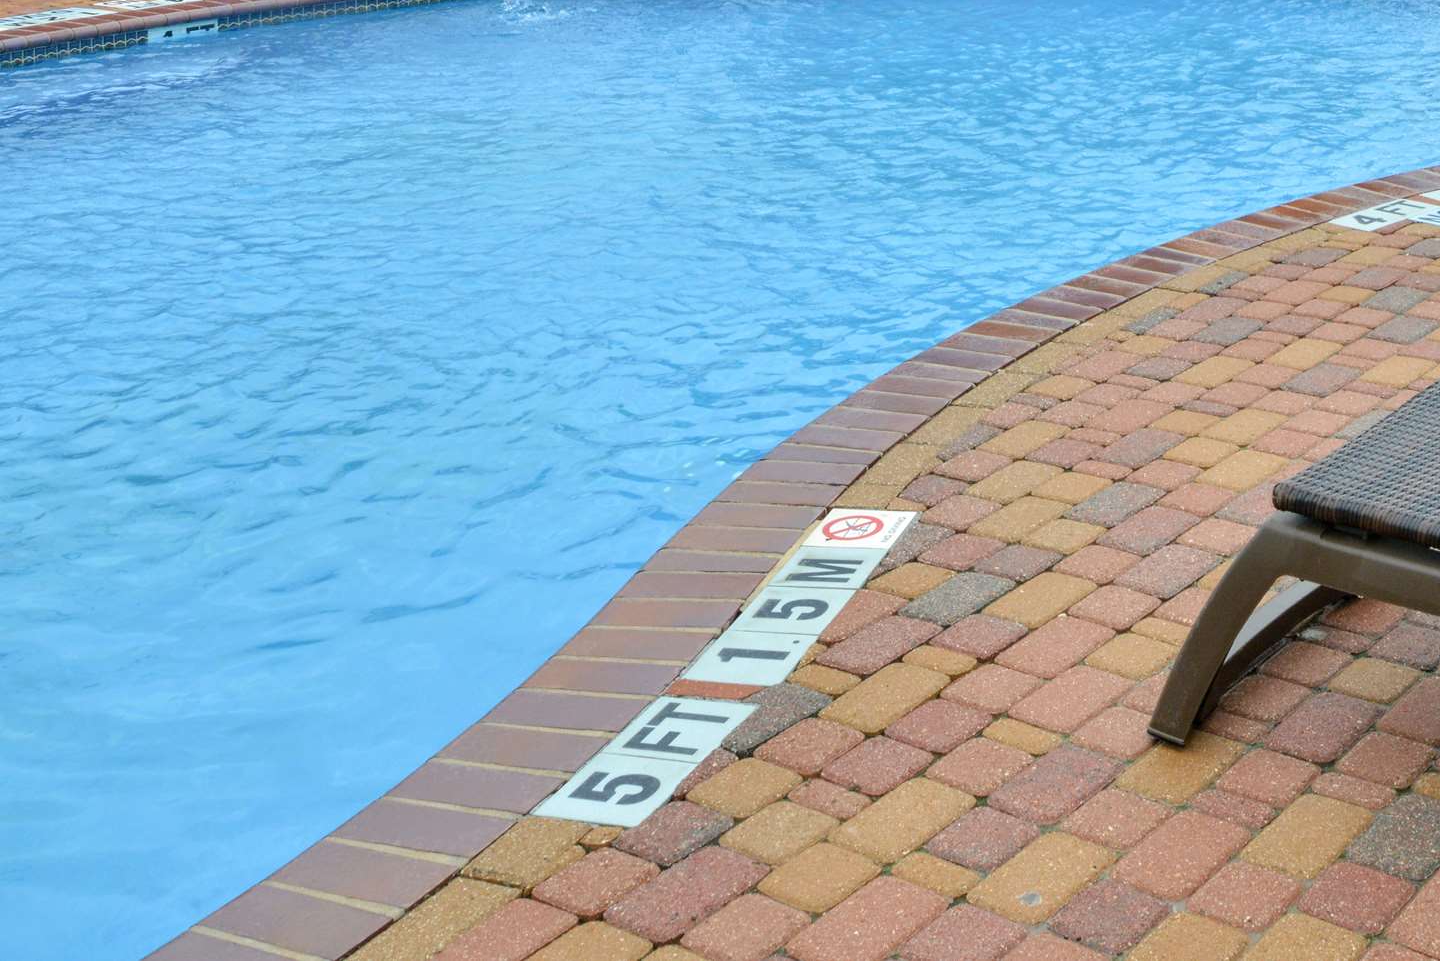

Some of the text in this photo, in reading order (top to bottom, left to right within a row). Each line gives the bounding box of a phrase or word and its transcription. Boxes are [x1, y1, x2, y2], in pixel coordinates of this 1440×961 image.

[1352, 214, 1388, 225] 4
[1375, 200, 1426, 216] FT
[569, 770, 662, 806] 5
[623, 701, 731, 757] FT
